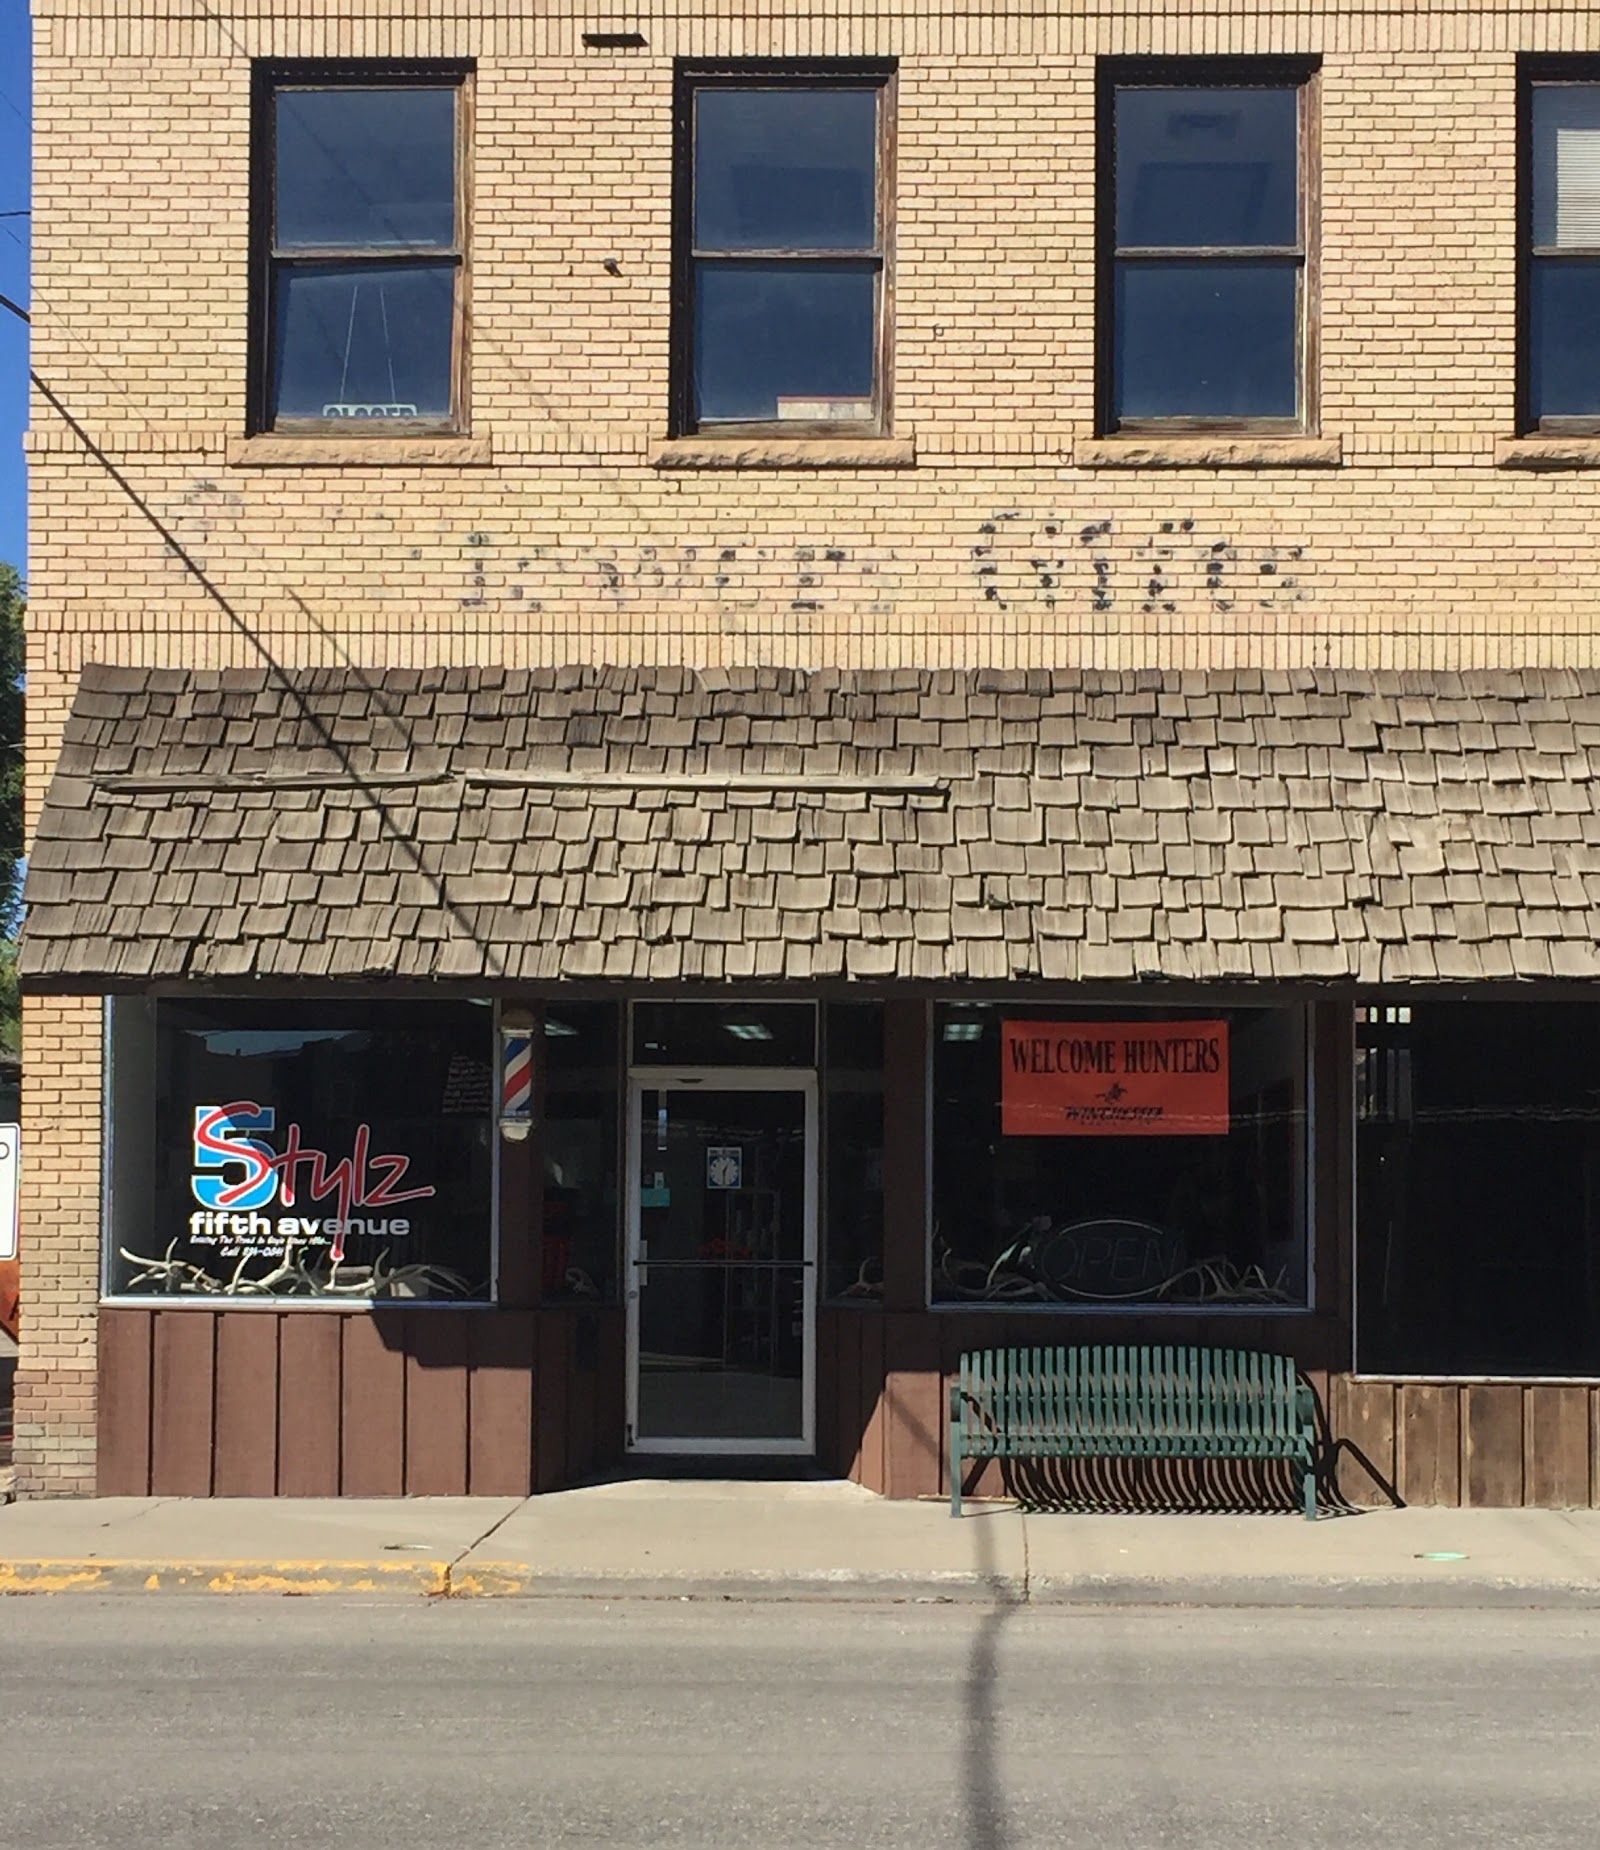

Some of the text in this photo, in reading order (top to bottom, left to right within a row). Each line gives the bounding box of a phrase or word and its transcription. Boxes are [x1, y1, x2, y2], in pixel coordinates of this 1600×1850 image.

[1009, 1038, 1220, 1074] WELCOME HUNTERS
[189, 1211, 411, 1236] fifth avenue
[1041, 1236, 1182, 1280] OPEN
